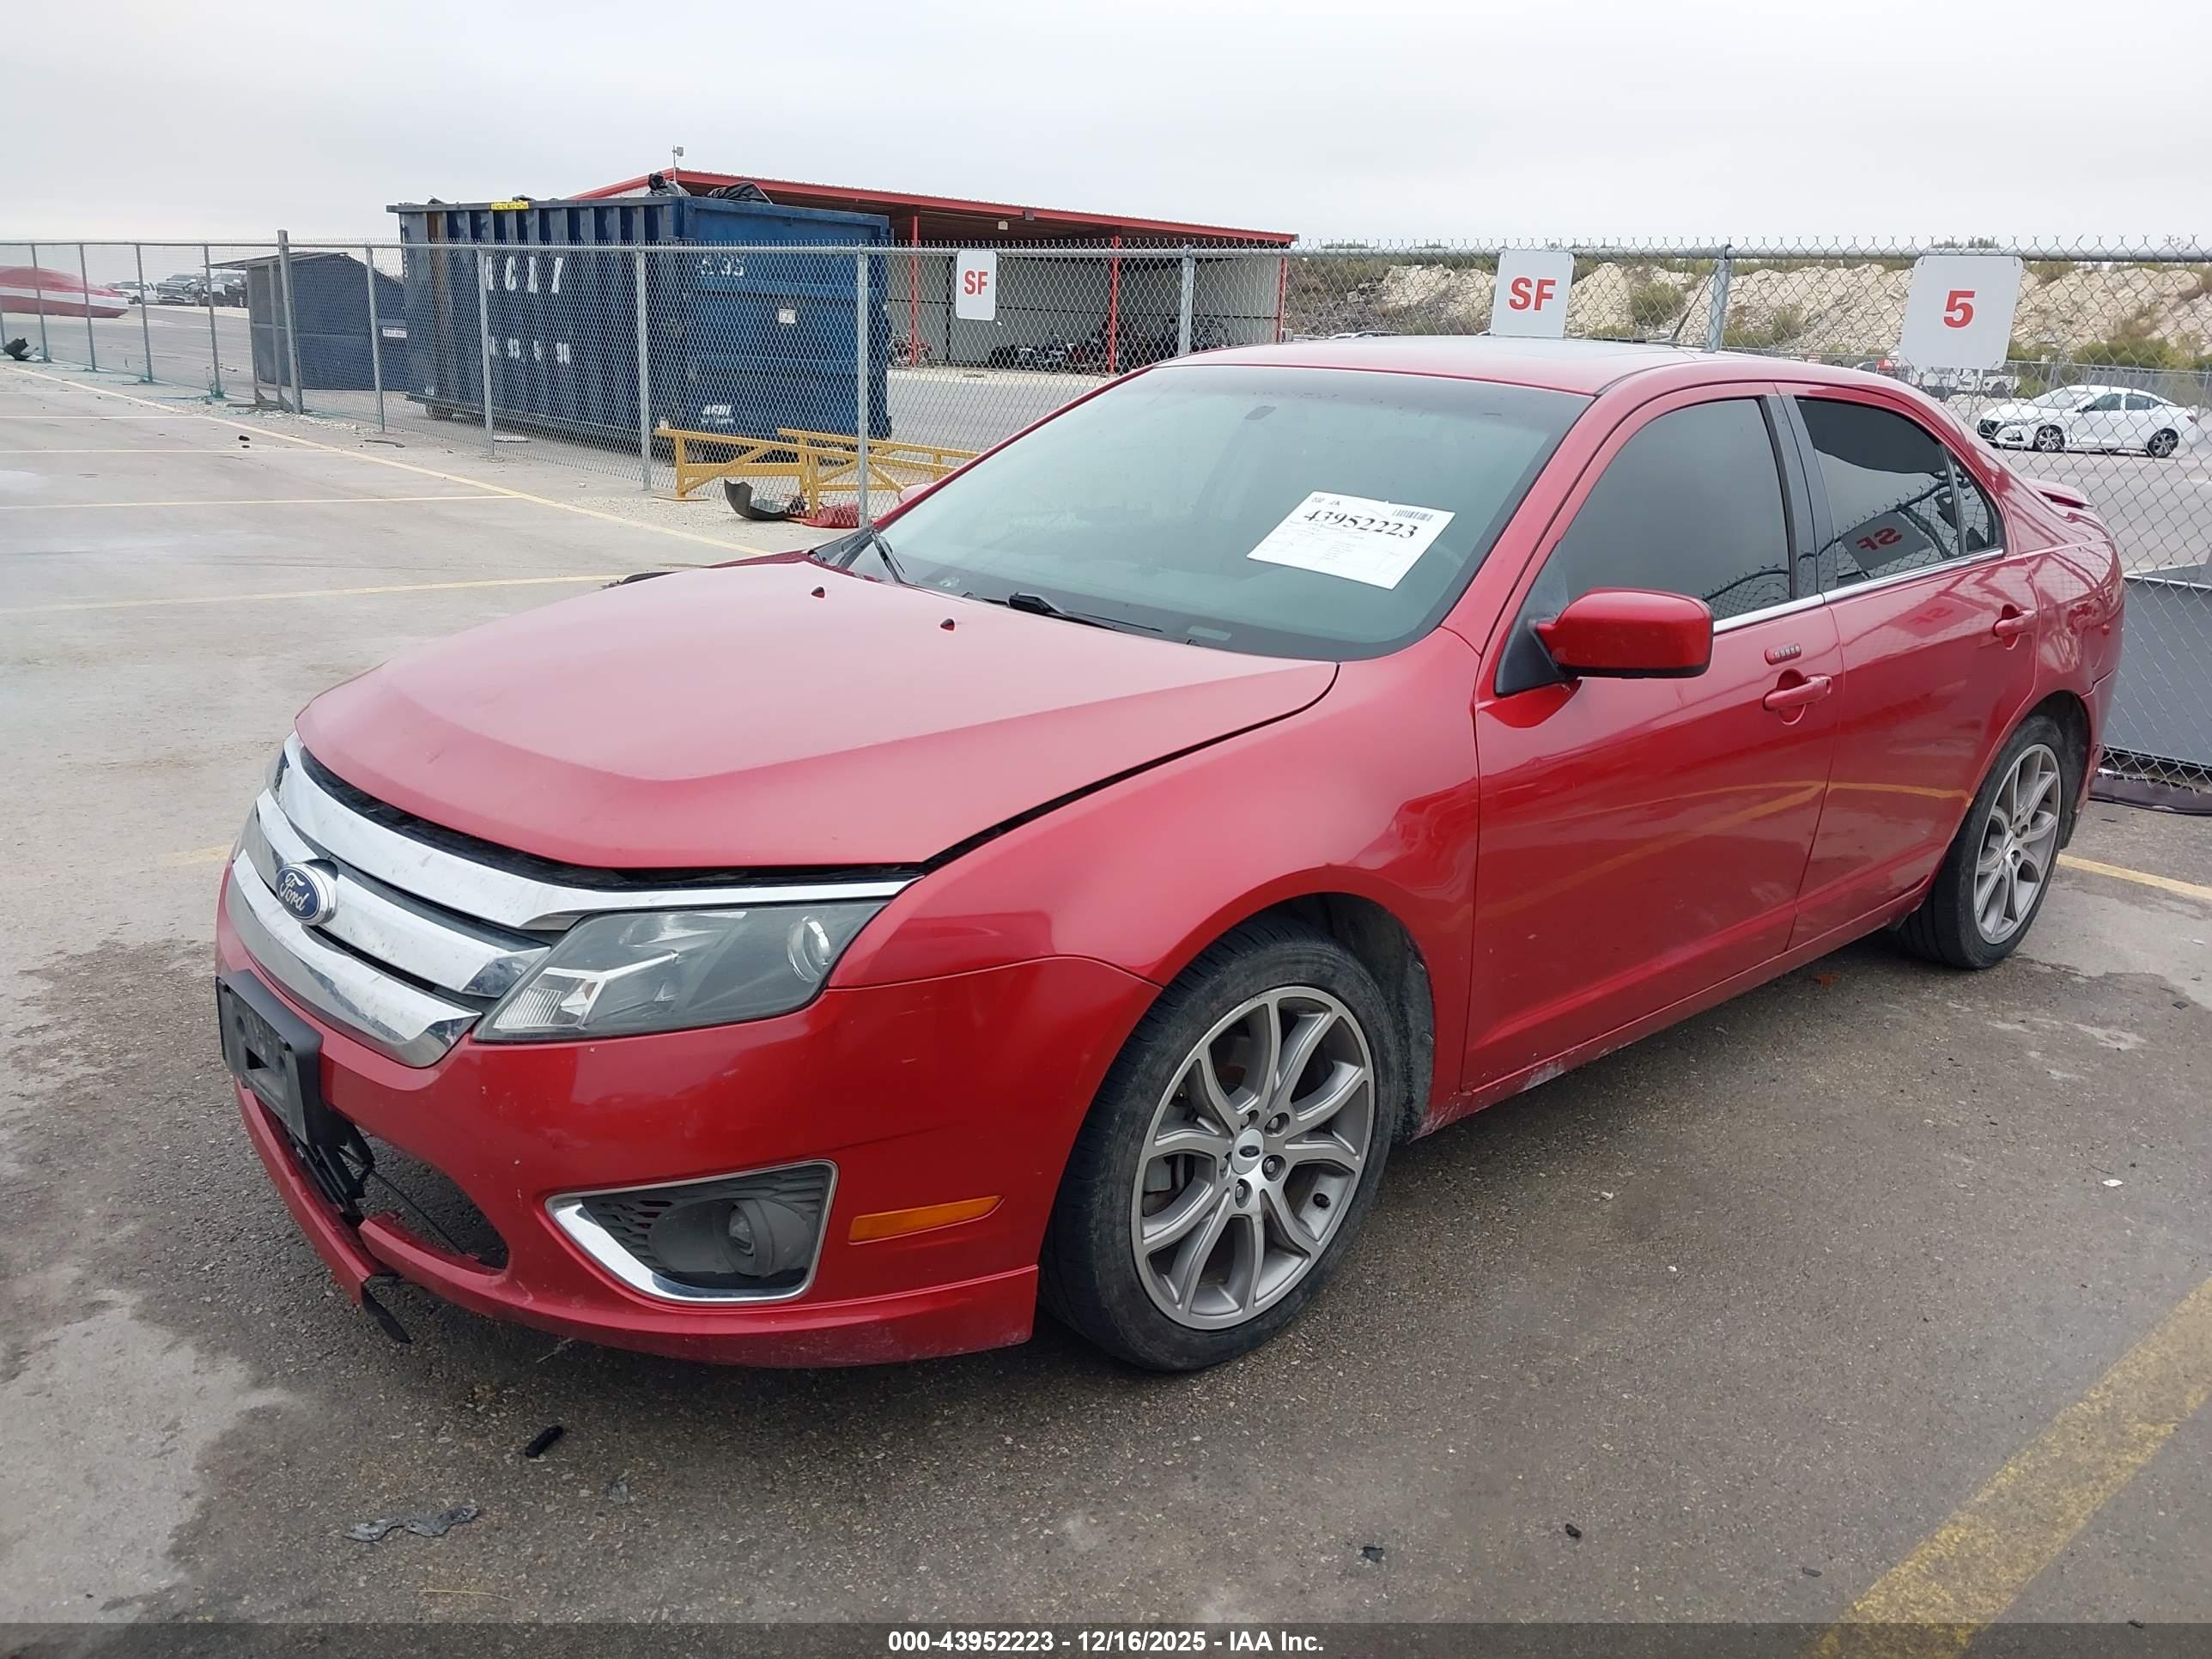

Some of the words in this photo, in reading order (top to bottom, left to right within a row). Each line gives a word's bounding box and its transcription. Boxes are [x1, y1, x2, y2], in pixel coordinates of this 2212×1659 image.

[963, 270, 988, 295] SF
[1509, 276, 1557, 311] SF
[1943, 290, 1976, 328] 5
[1304, 509, 1419, 538] 43952223
[279, 872, 310, 912] Ford
